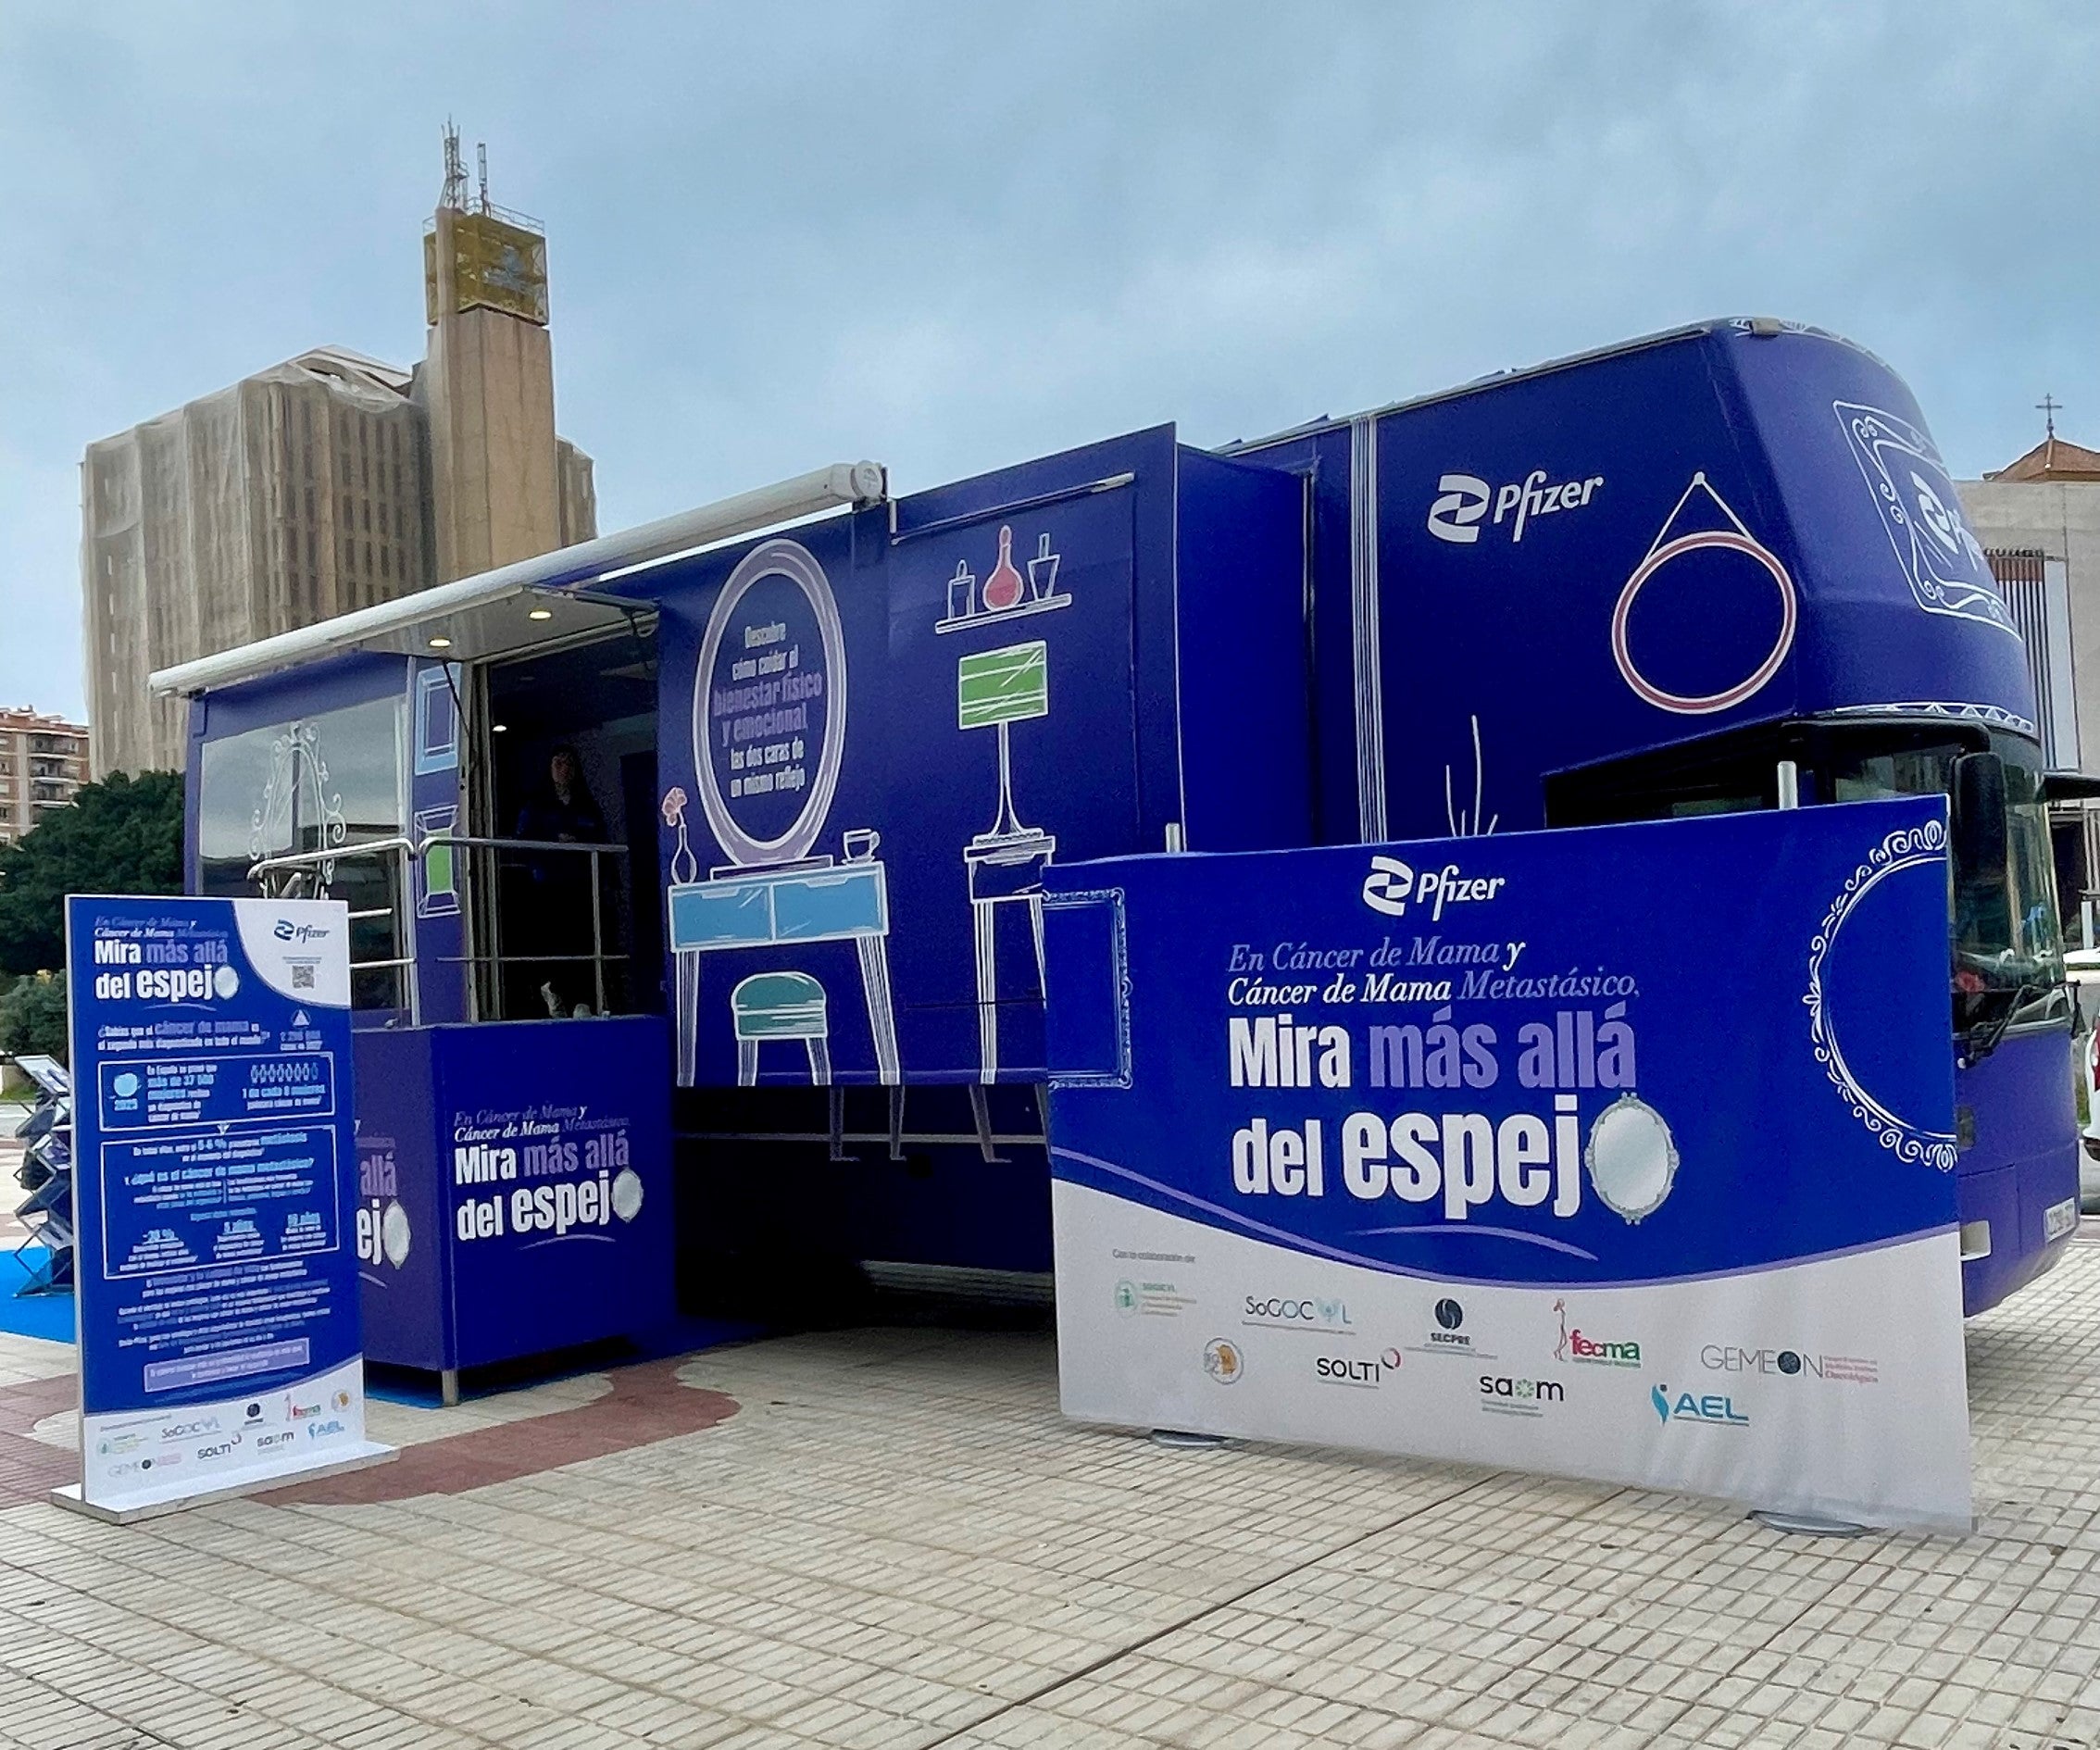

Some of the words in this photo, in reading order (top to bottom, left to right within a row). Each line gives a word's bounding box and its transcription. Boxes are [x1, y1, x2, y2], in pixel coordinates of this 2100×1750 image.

[1493, 469, 1605, 543] Pfizer
[1417, 865, 1506, 921] Pfizer
[296, 924, 331, 944] Pfizer
[94, 939, 142, 964] Mira
[145, 939, 188, 964] más
[193, 938, 229, 963] allá
[1228, 944, 1264, 972] En
[1271, 941, 1364, 969] Cáncer
[1369, 937, 1402, 965] de
[1406, 935, 1500, 966] Mama
[1502, 941, 1527, 971] y
[95, 972, 130, 999] del
[1228, 975, 1318, 1006] Cáncer
[1322, 973, 1355, 1004] de
[1360, 973, 1452, 1003] Mama
[1228, 1014, 1351, 1087] Mira
[1369, 1005, 1498, 1088] más
[1518, 1001, 1637, 1088] allá
[522, 1106, 538, 1120] de
[578, 1106, 587, 1120] y
[455, 1126, 500, 1143] Cáncer
[502, 1121, 518, 1139] de
[519, 1119, 560, 1137] Mama
[455, 1144, 517, 1185] Mira
[523, 1135, 579, 1177] más
[584, 1128, 630, 1169] allá
[1232, 1118, 1324, 1196] del
[359, 1151, 398, 1196] allá
[456, 1195, 504, 1241] del
[1430, 1332, 1471, 1345] SECPRE
[1569, 1329, 1641, 1360] fecma
[1317, 1357, 1380, 1382] SOLTI
[1673, 1393, 1749, 1421] AEL
